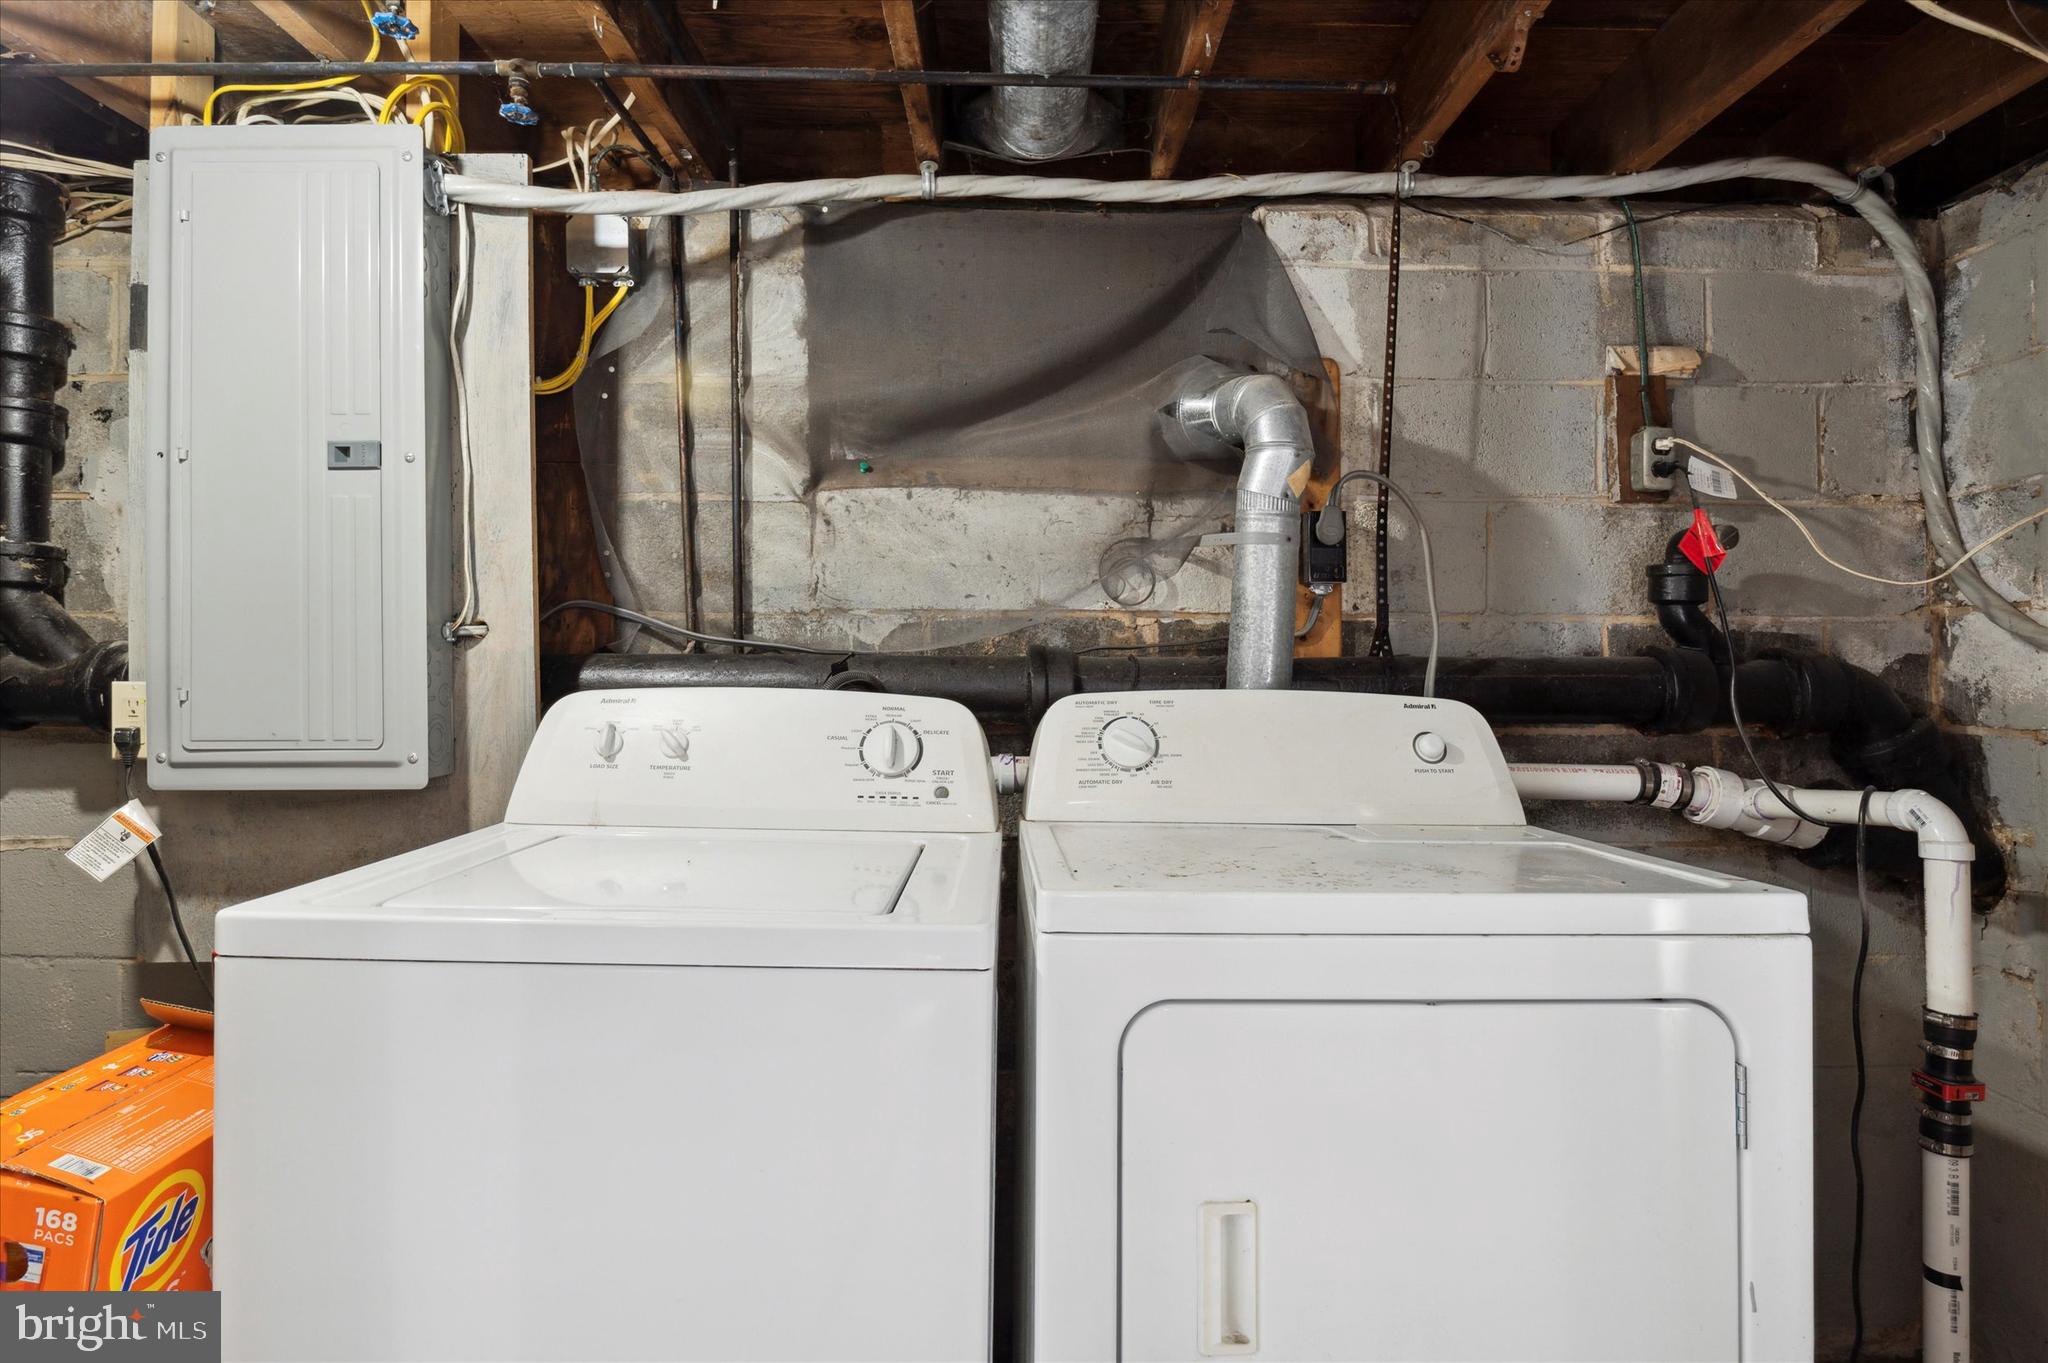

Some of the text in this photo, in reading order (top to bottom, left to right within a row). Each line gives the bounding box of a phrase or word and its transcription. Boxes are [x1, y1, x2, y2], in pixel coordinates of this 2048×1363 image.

[35, 1207, 78, 1232] 168
[33, 1228, 74, 1247] PACS
[122, 1189, 199, 1291] Tide
